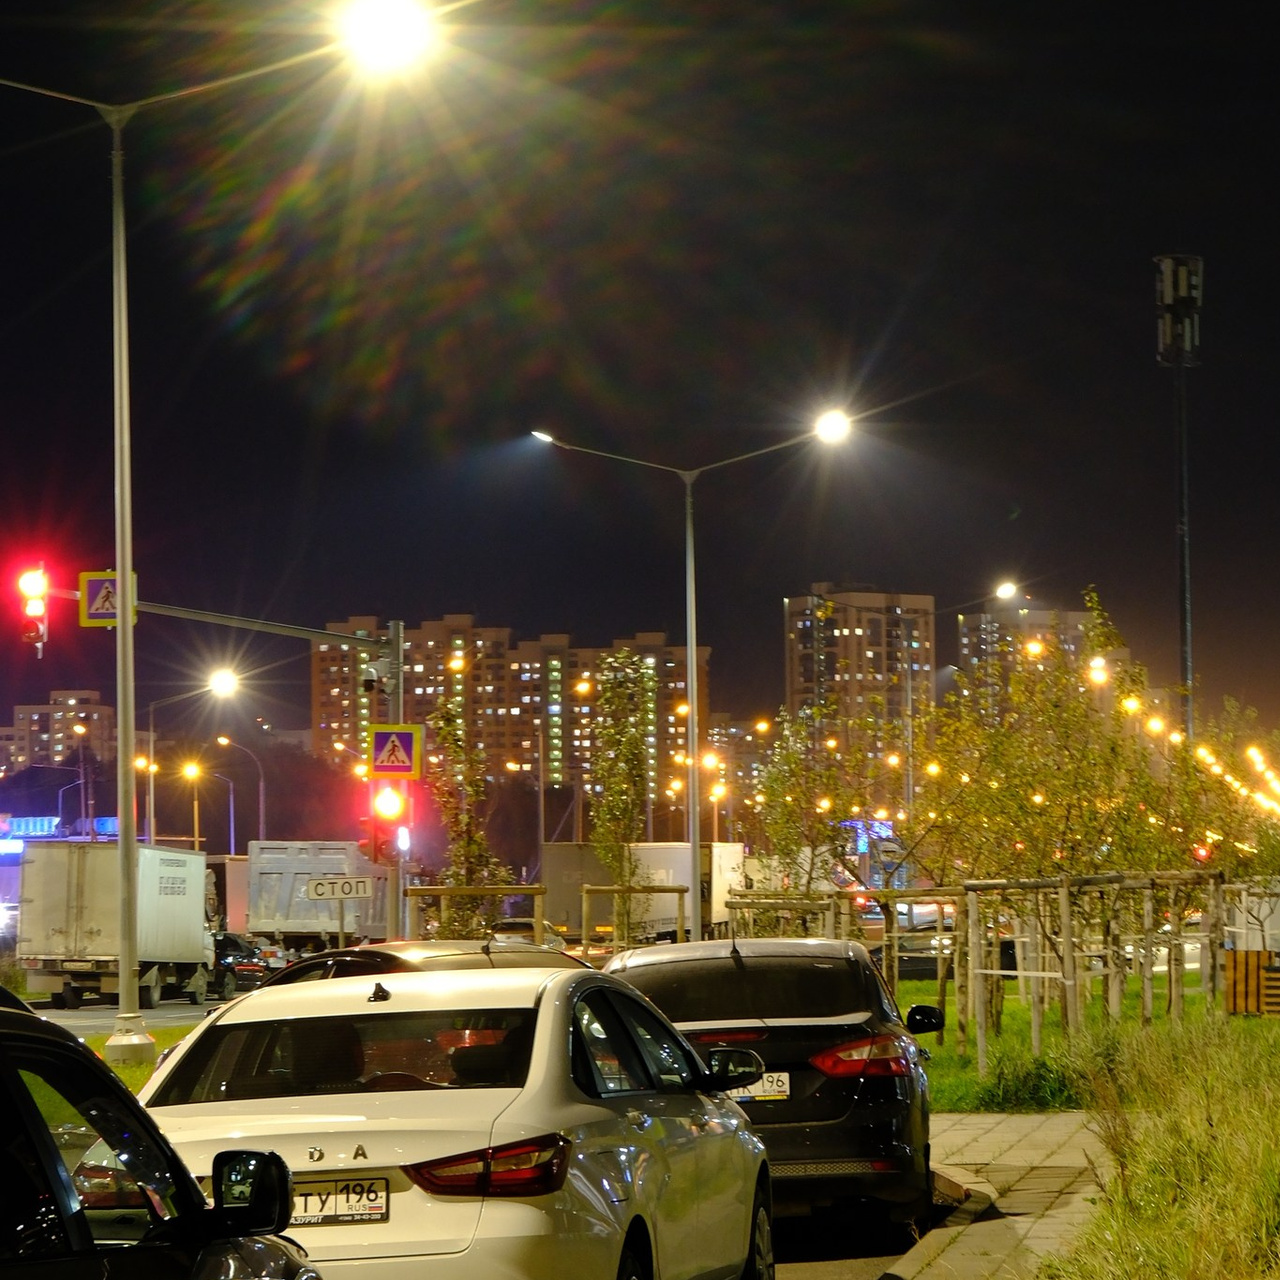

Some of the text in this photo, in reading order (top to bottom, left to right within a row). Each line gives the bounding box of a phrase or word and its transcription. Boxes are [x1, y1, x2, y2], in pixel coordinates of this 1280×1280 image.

[314, 881, 367, 897] СТОП
[292, 1182, 379, 1214] ТУ 196
[347, 1204, 368, 1212] RUS
